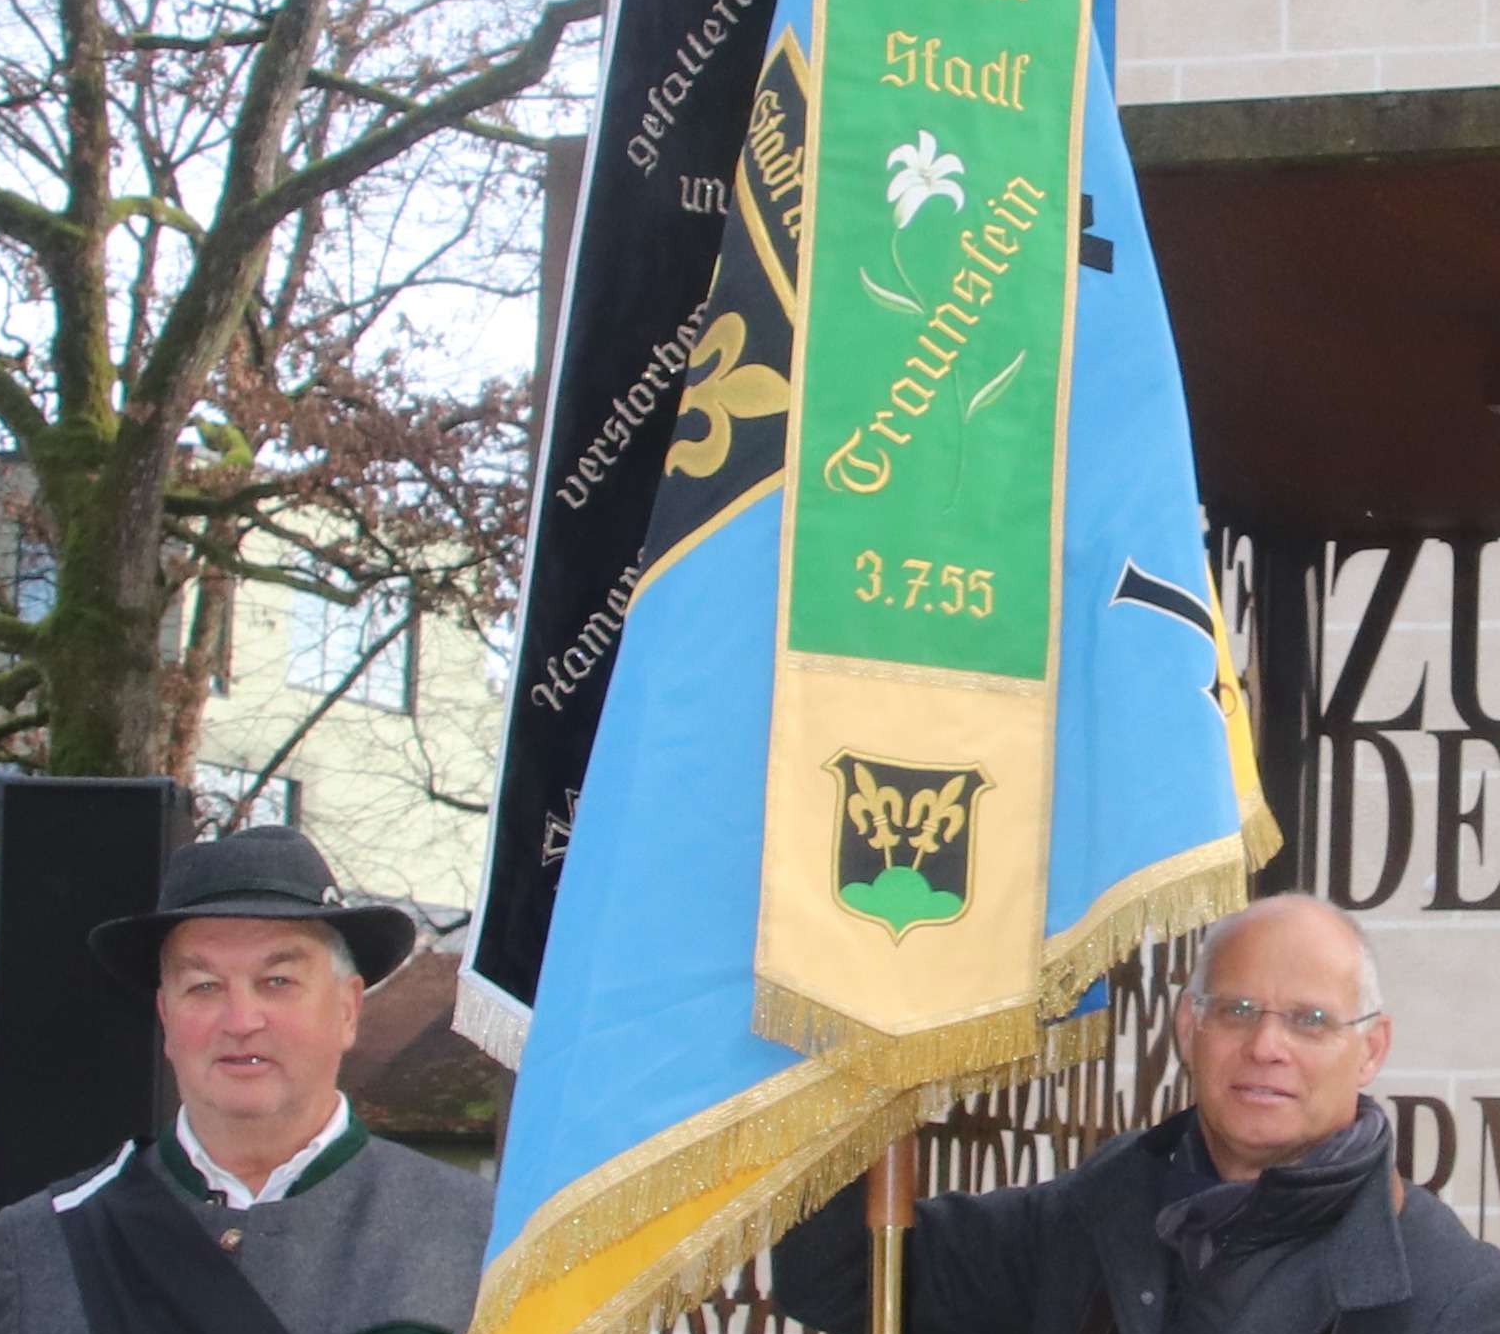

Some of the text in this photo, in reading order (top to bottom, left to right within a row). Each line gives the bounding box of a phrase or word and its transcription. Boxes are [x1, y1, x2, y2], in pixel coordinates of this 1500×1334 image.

[880, 29, 1031, 112] Stadt
[822, 174, 1047, 495] Traunstein
[854, 548, 997, 619] 3.7.55
